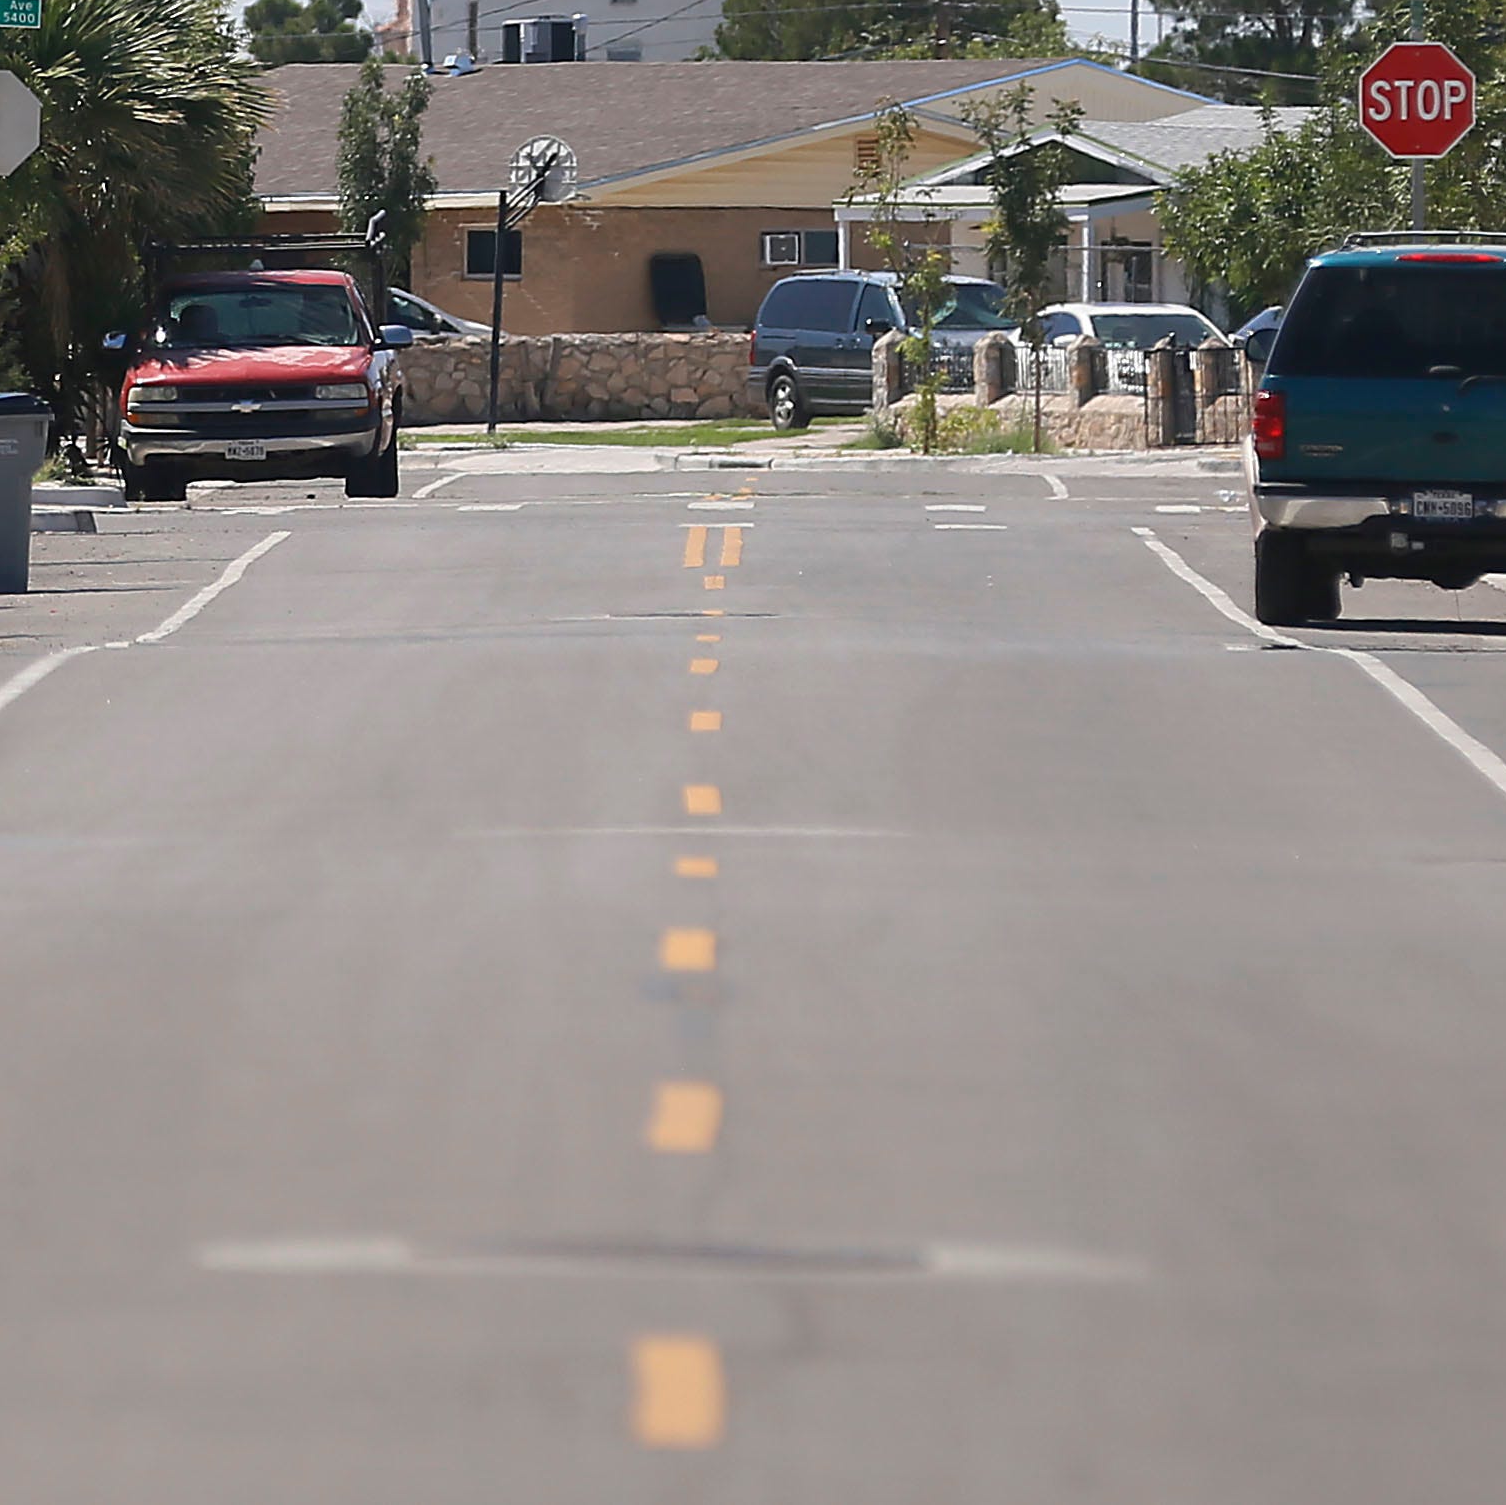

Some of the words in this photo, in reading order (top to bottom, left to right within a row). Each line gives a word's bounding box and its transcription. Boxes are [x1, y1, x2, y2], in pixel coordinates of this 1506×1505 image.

[9, 0, 34, 11] Ave
[3, 11, 36, 24] 5400
[1368, 79, 1467, 122] STOP
